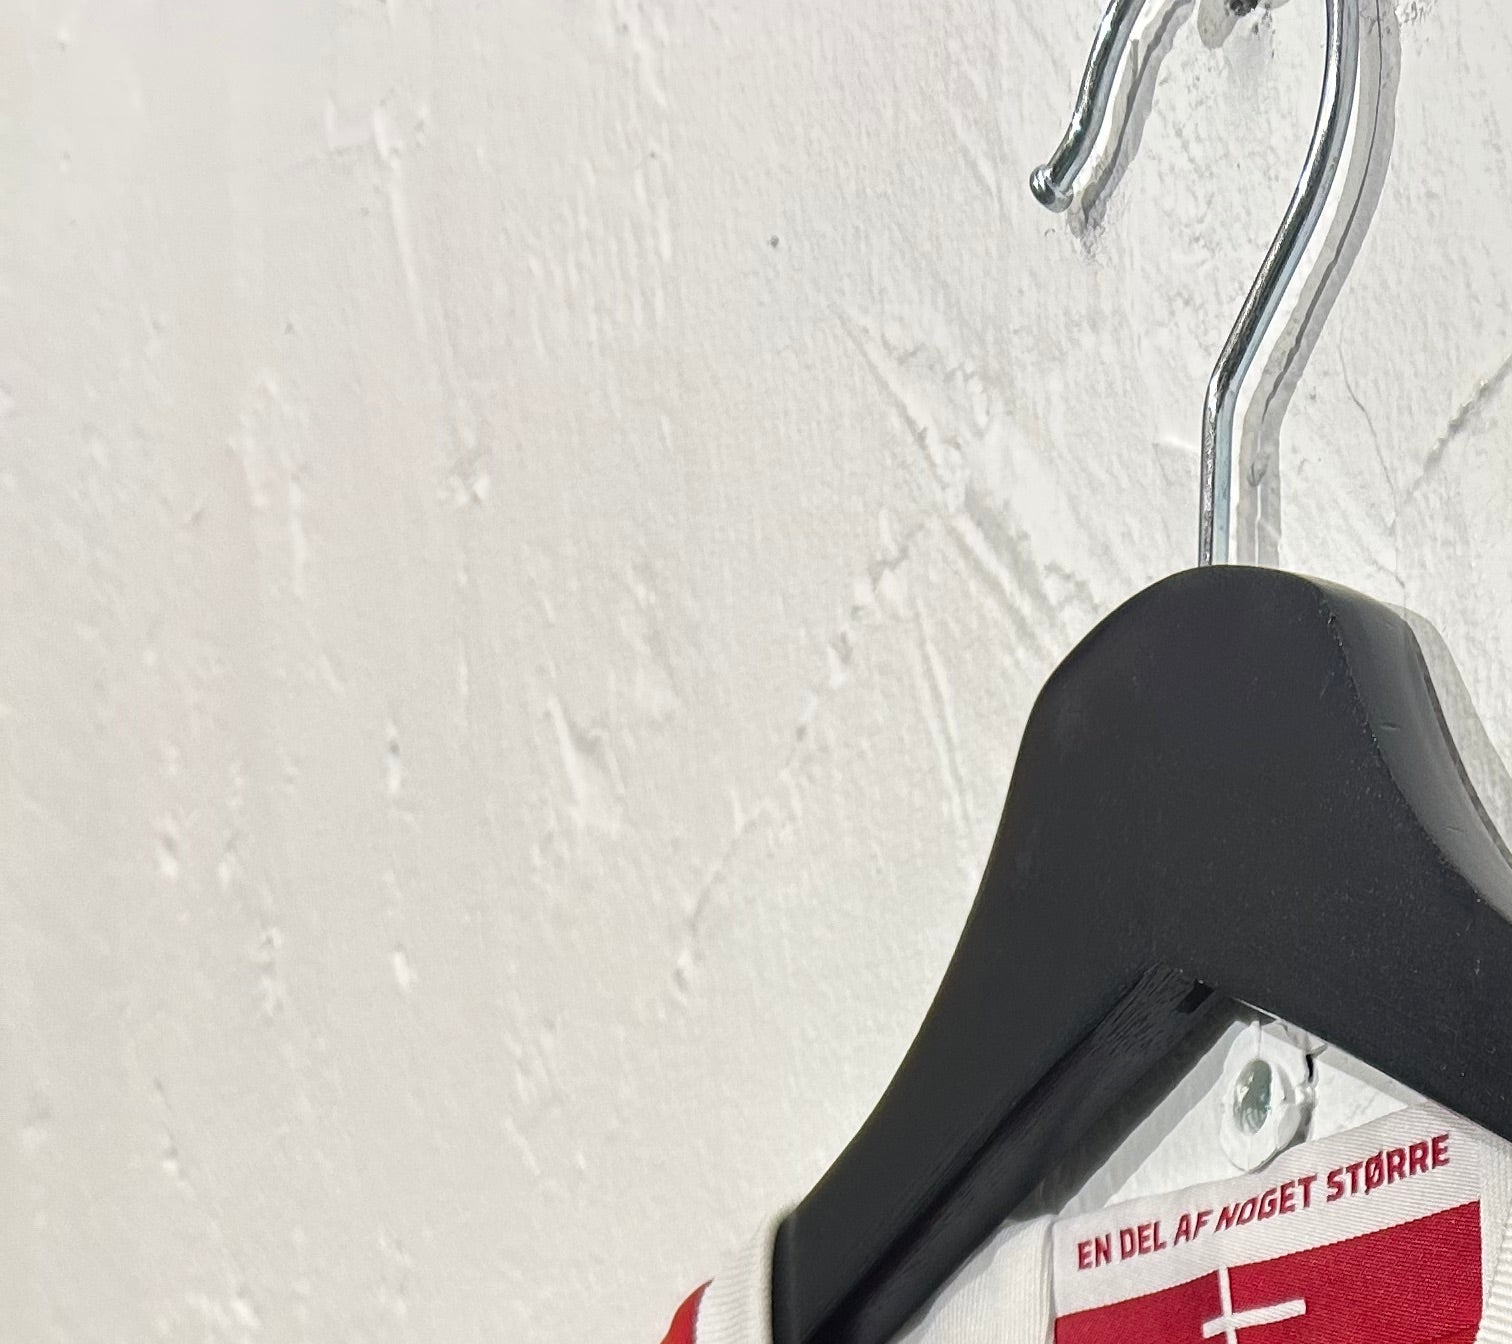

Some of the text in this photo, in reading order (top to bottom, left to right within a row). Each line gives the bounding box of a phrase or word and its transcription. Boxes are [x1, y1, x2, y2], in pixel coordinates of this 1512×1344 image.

[1076, 1133, 1451, 1270] EN DEL AF NOGET STØRRE
